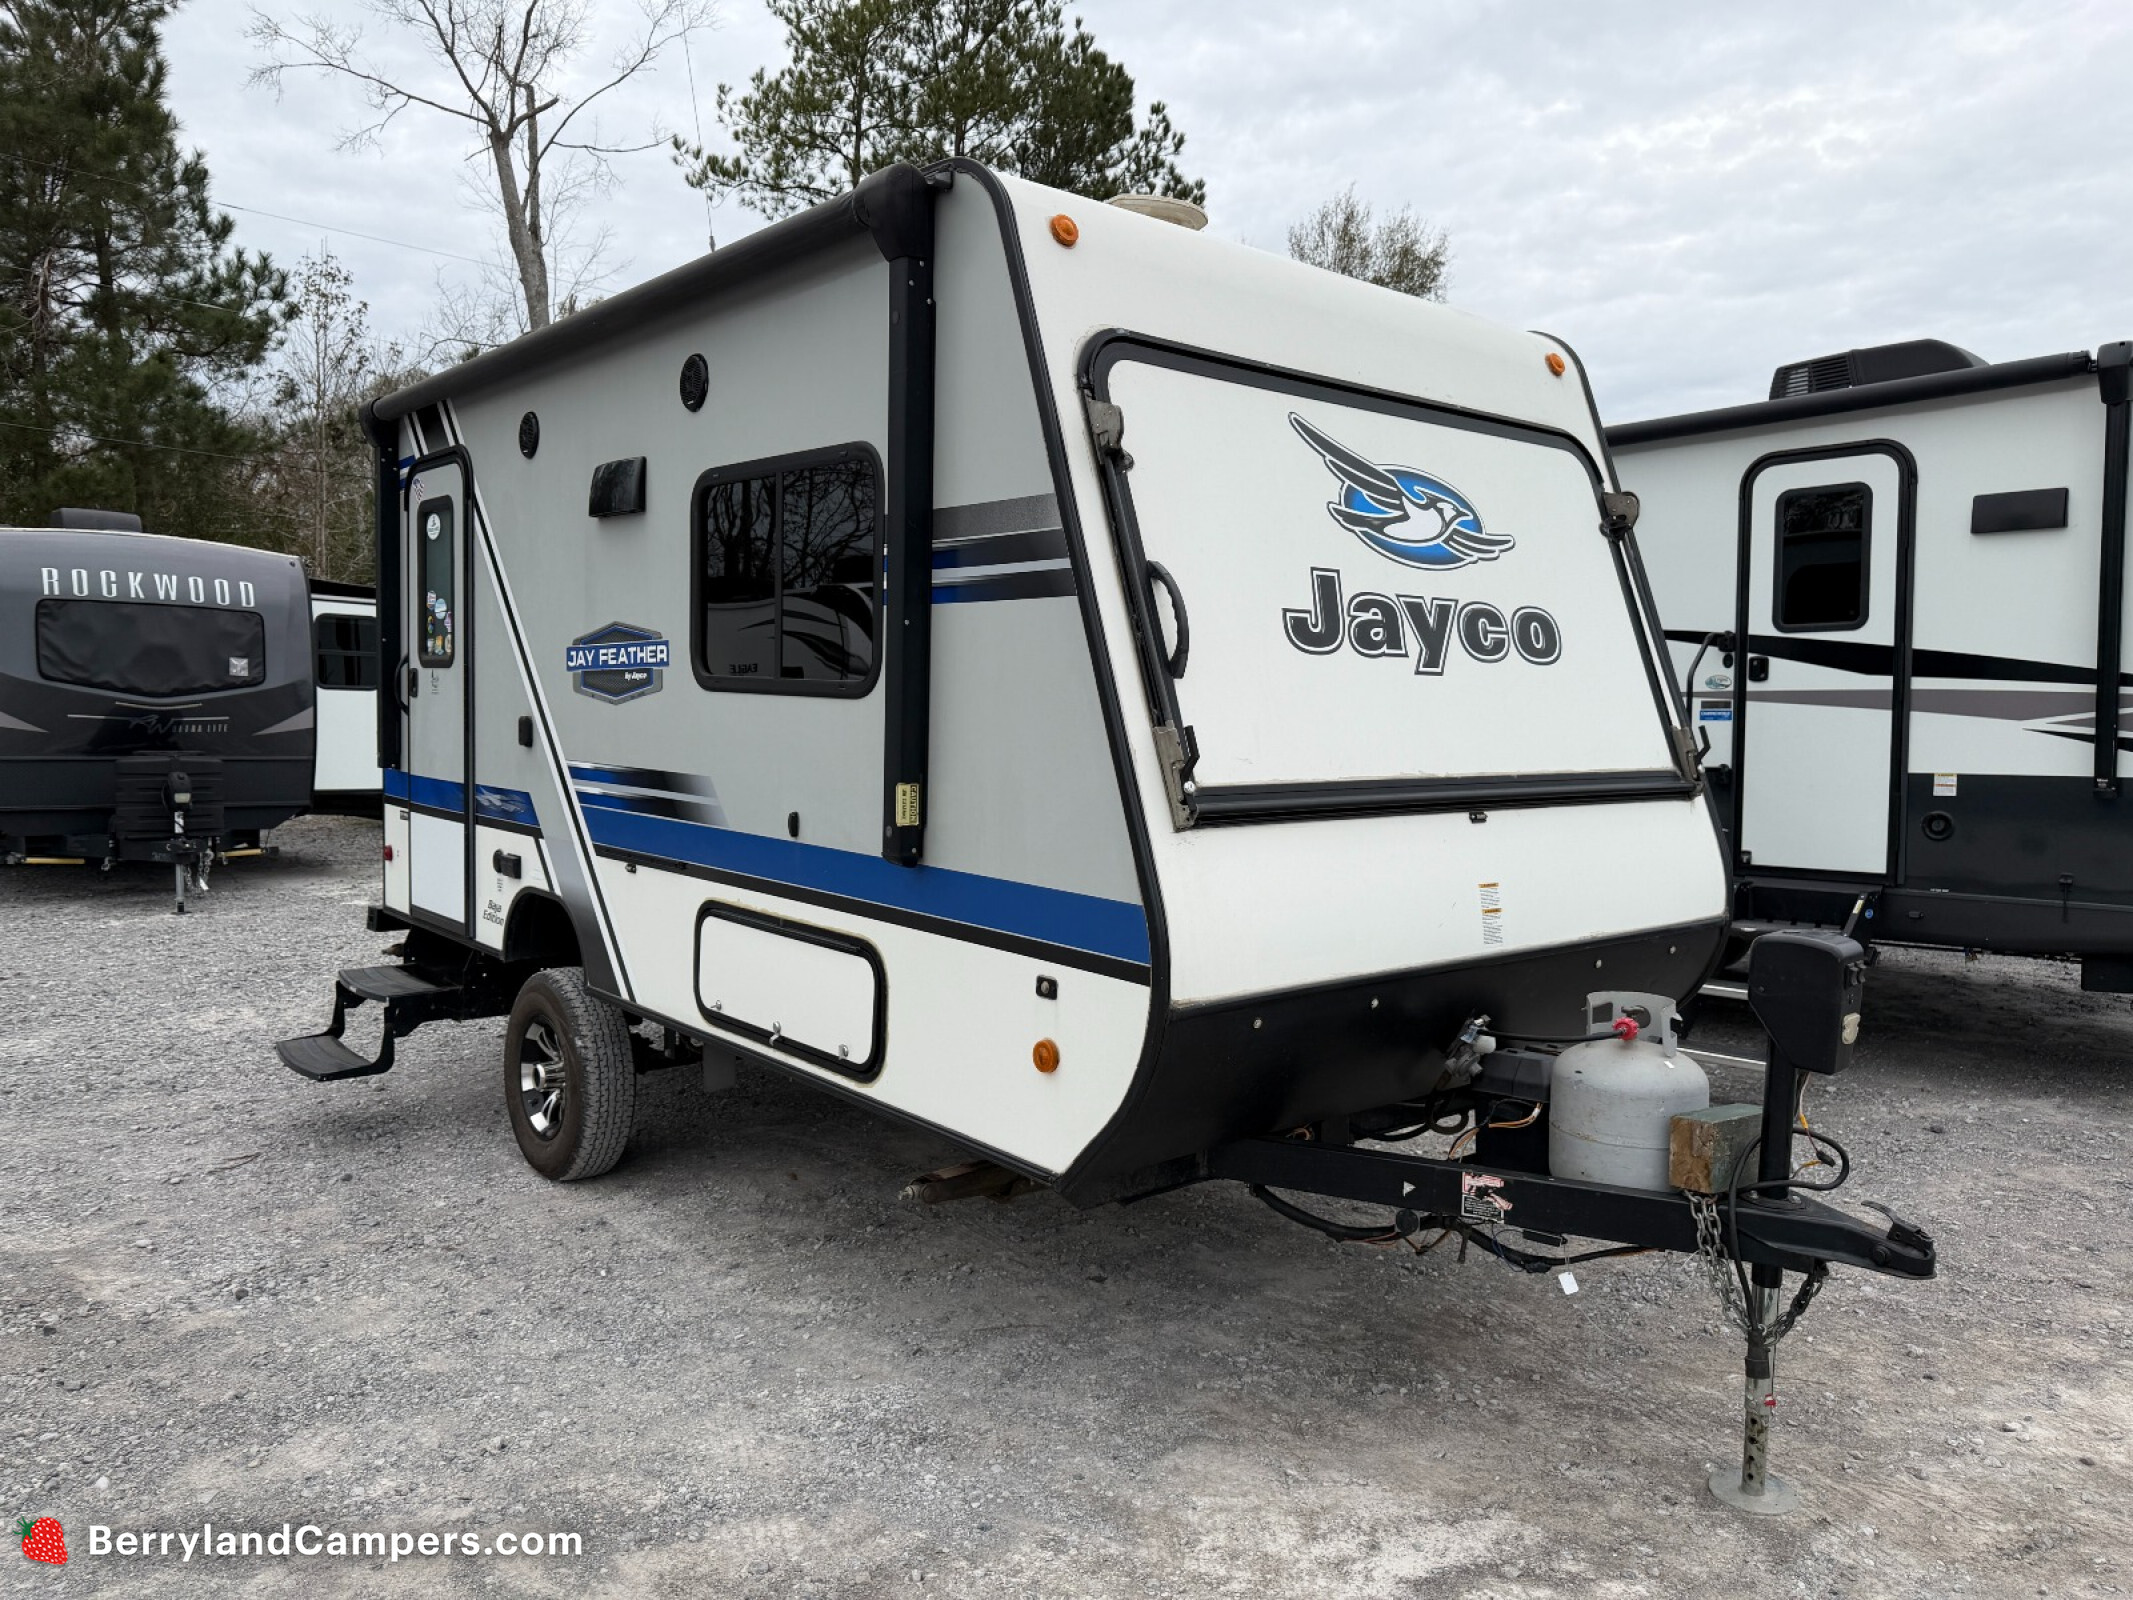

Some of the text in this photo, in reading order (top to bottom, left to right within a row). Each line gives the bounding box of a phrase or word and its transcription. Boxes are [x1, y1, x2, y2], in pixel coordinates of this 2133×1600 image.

[41, 567, 256, 607] ROCKWOOD
[1281, 566, 1562, 676] Jayco
[567, 645, 668, 667] JAY FEATHER
